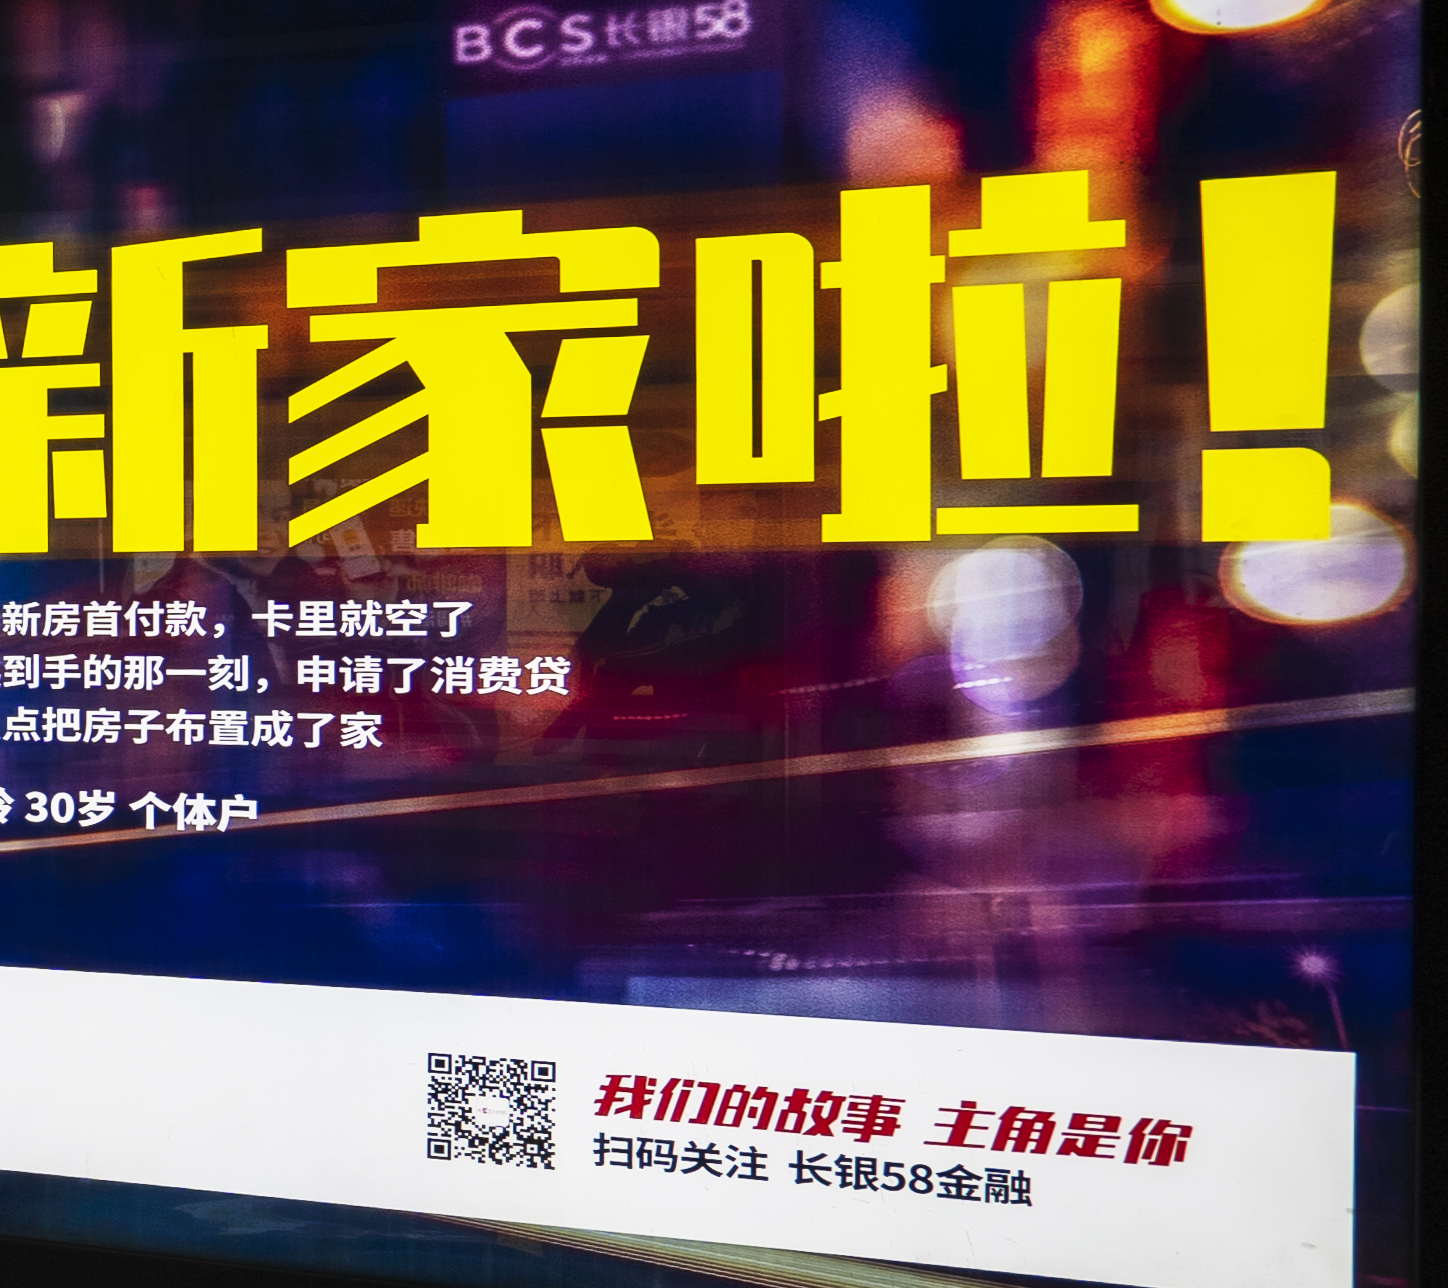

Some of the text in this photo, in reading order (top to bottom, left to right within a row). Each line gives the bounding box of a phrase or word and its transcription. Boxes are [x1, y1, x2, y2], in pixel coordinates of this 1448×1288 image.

[24, 788, 117, 829] 30岁
[129, 791, 260, 833] 个体户
[592, 1071, 1196, 1168] 我们的故事 主角是你
[592, 1130, 1035, 1209] 扫码关注 长银58金融
